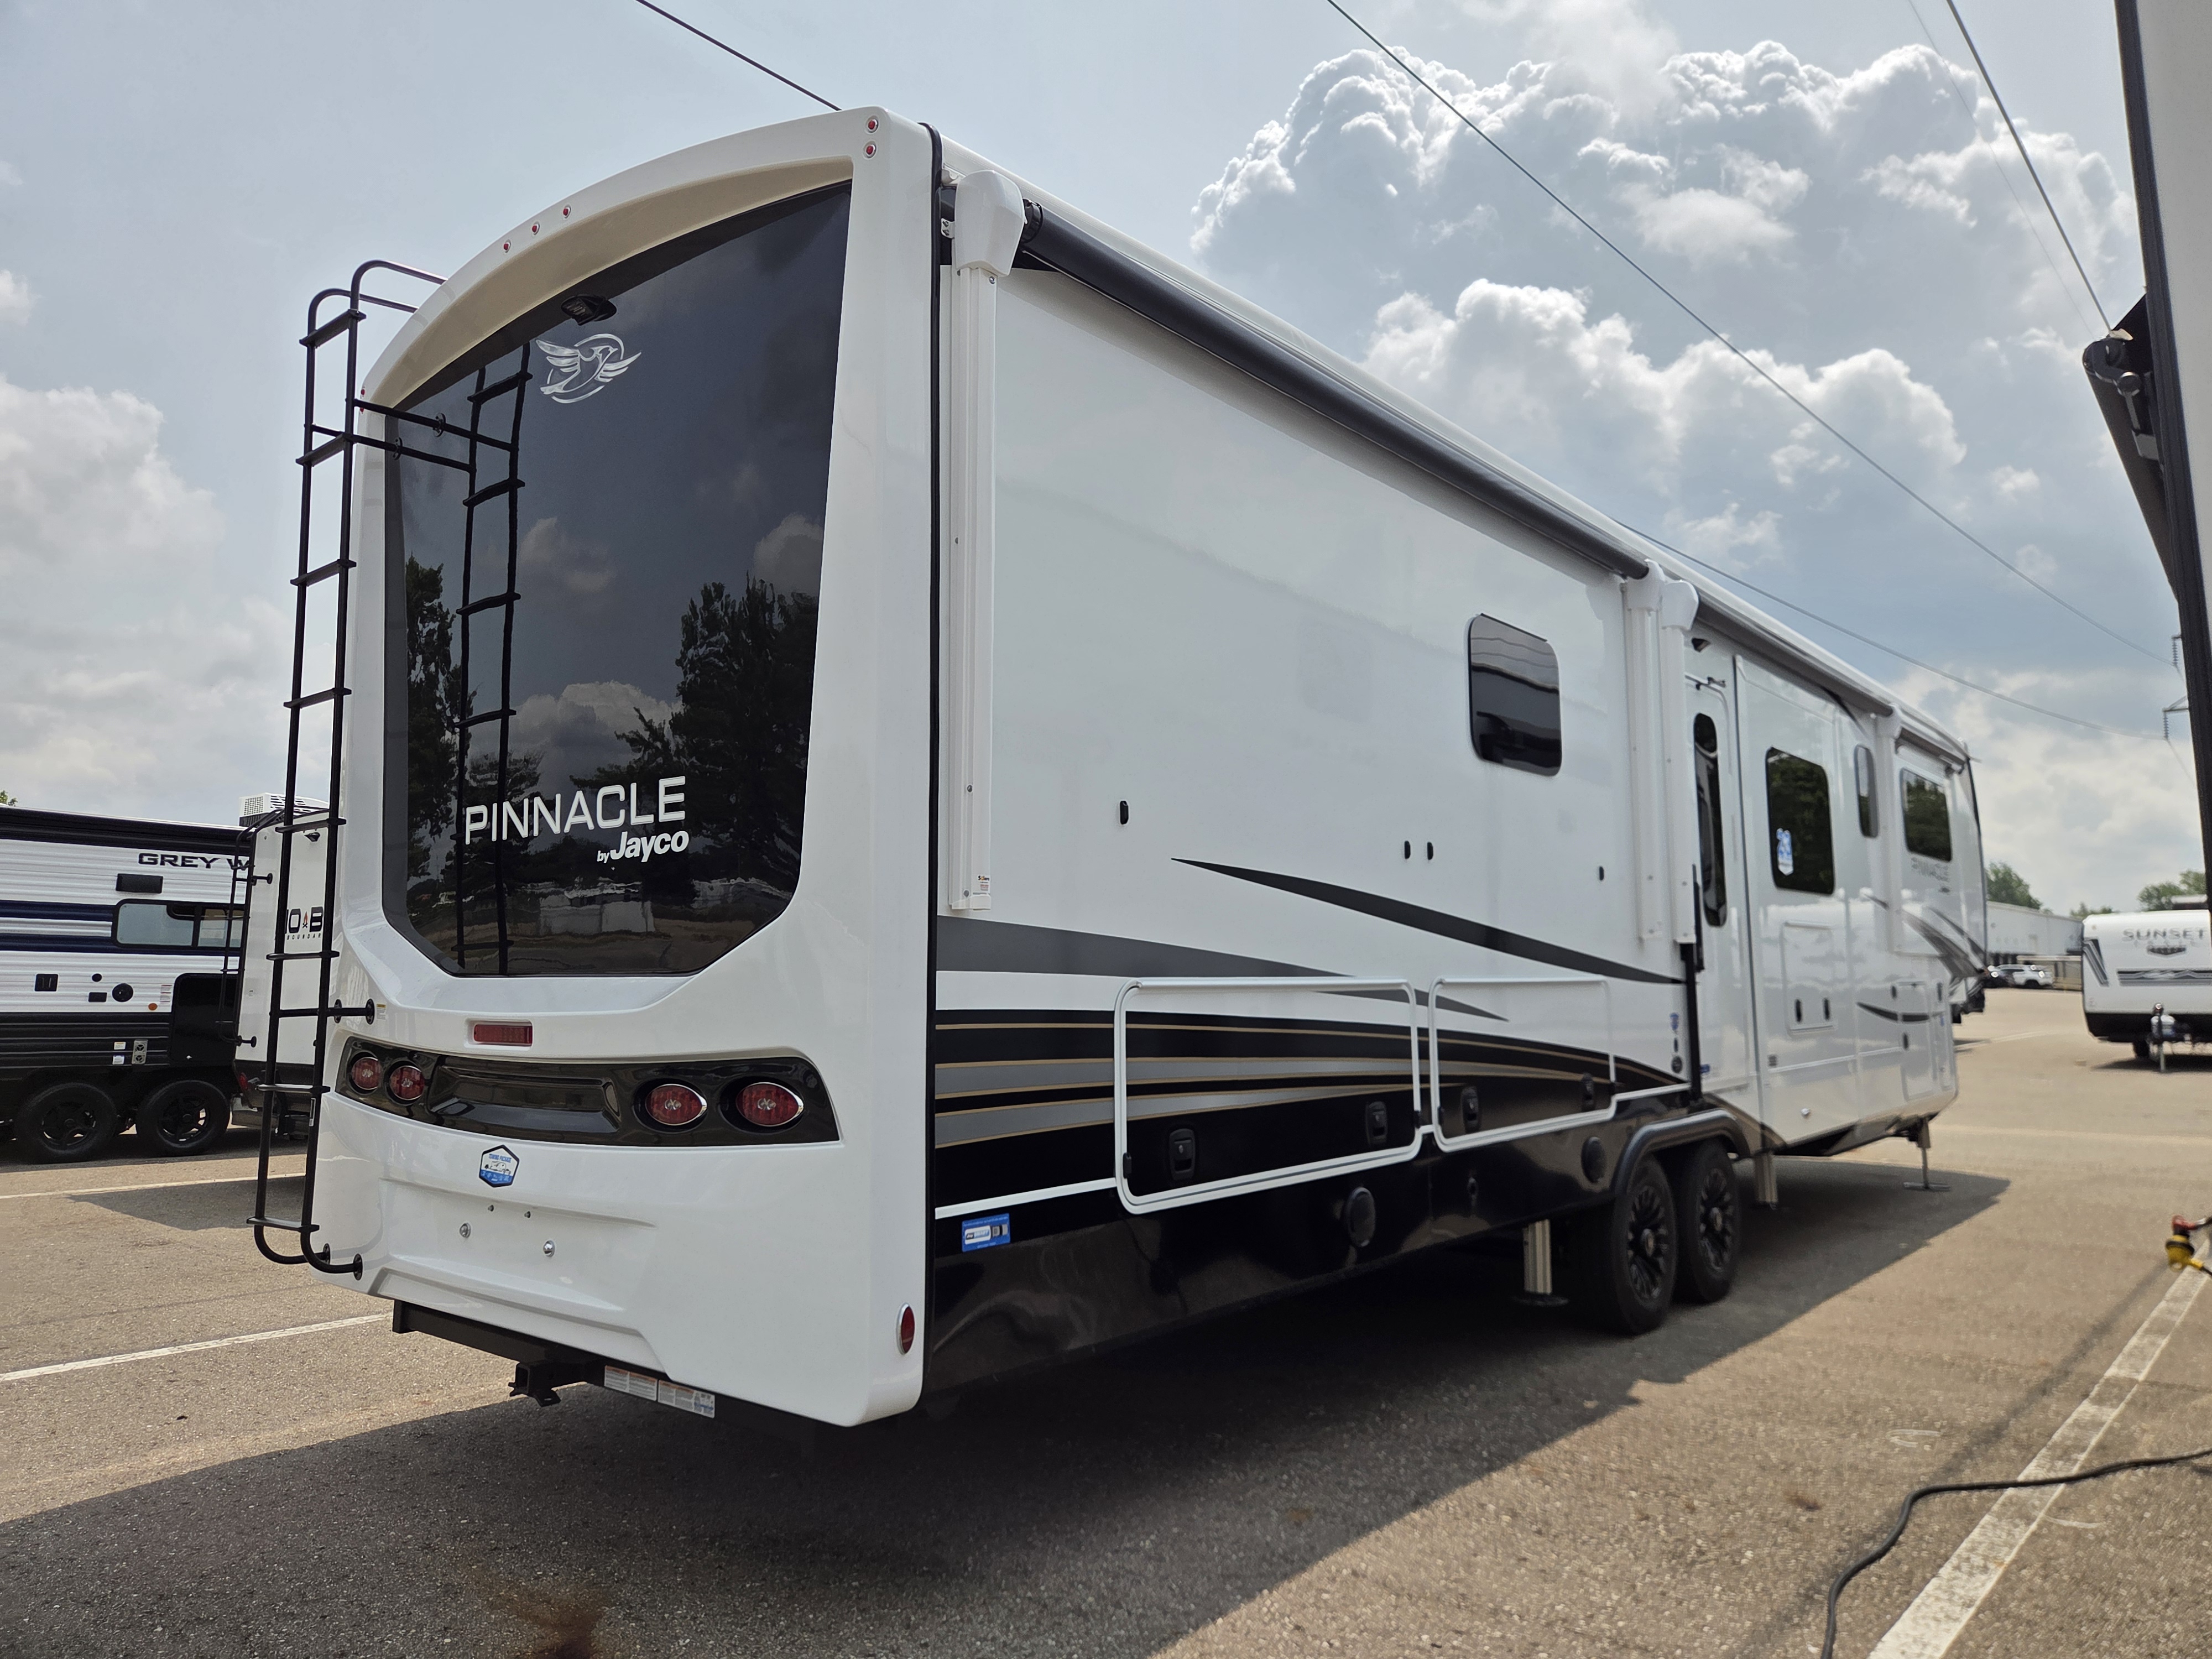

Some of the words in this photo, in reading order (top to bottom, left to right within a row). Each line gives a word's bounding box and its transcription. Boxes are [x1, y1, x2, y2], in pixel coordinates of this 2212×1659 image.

[465, 776, 686, 845] PINNACLE
[597, 851, 610, 864] by
[610, 831, 690, 863] Jayco
[138, 853, 221, 869] GREY
[2122, 927, 2208, 942] SUNSET
